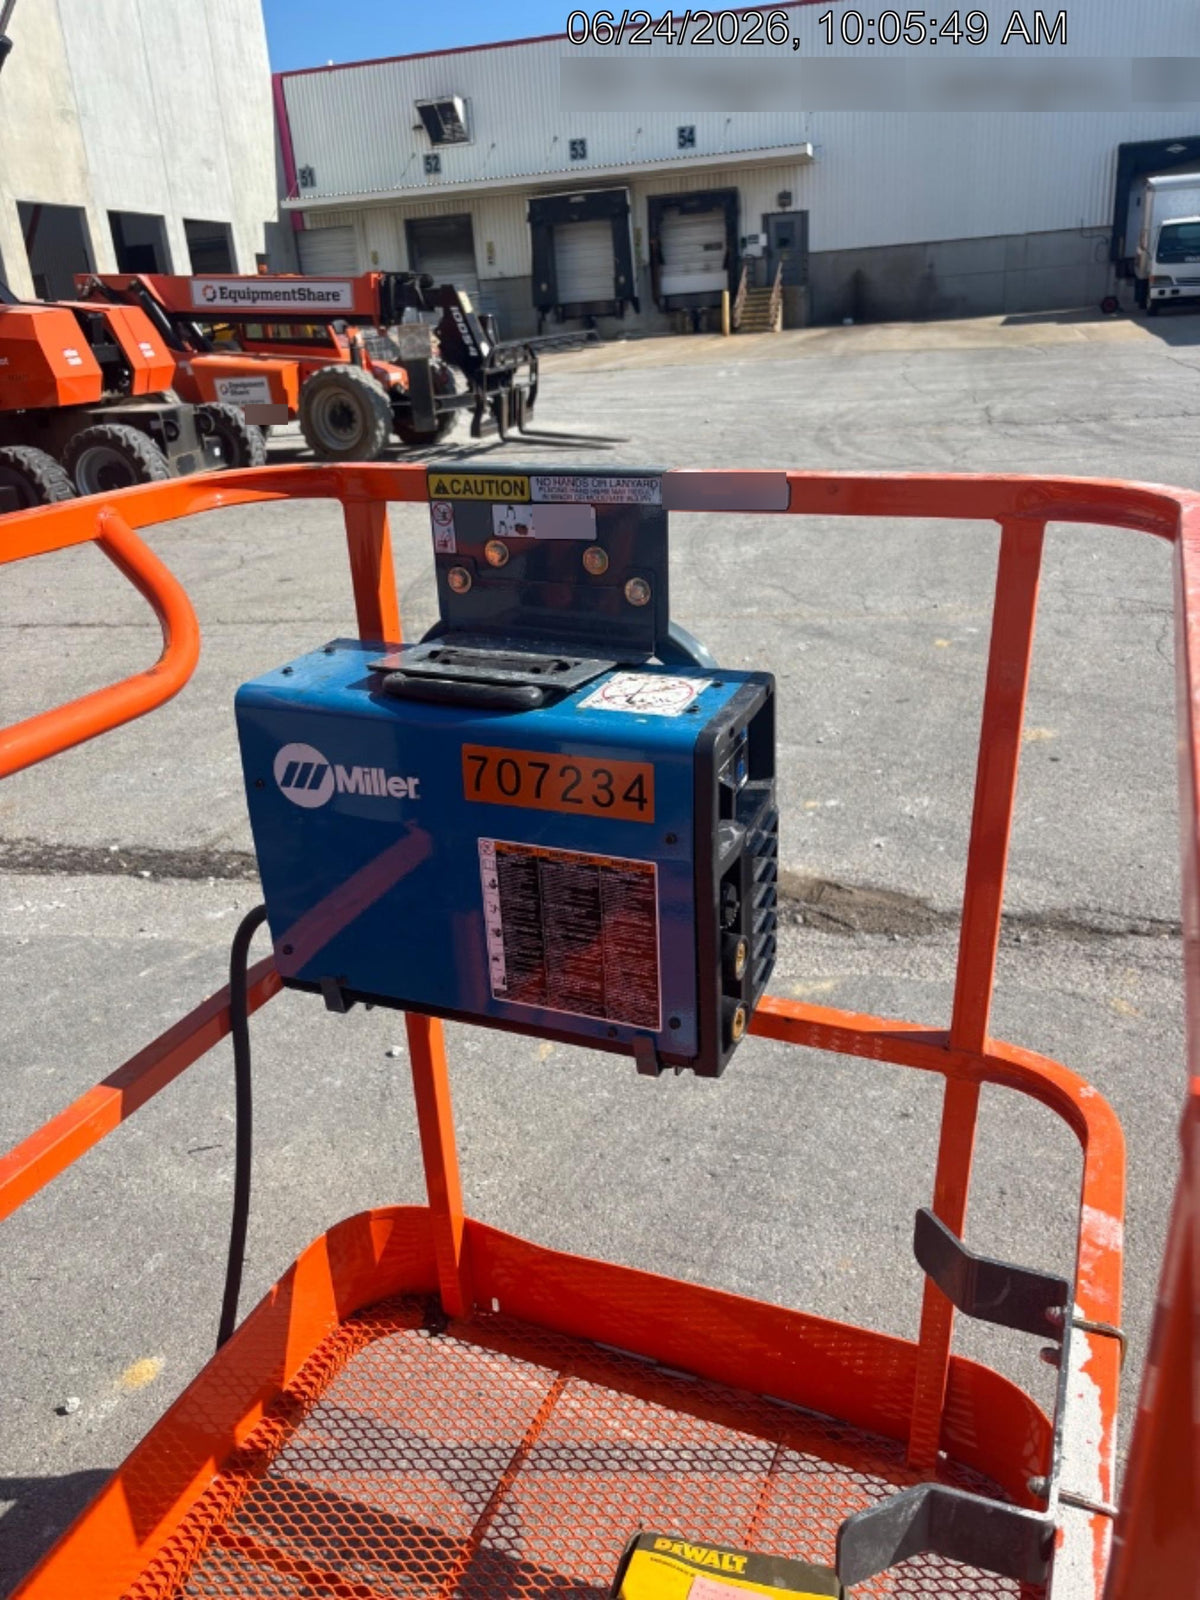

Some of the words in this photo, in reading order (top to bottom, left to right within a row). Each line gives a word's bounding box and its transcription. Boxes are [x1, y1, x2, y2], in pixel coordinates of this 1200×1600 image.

[678, 126, 695, 147] 54
[570, 140, 586, 160] 53
[425, 155, 440, 173] 52
[300, 170, 314, 187] 51
[218, 285, 341, 304] EquipmentShare
[450, 479, 525, 497] CAUTION
[536, 477, 551, 487] NO
[554, 477, 589, 488] HANDS
[609, 479, 659, 489] LANYARD
[335, 764, 420, 799] Miller
[466, 755, 648, 811] 707234
